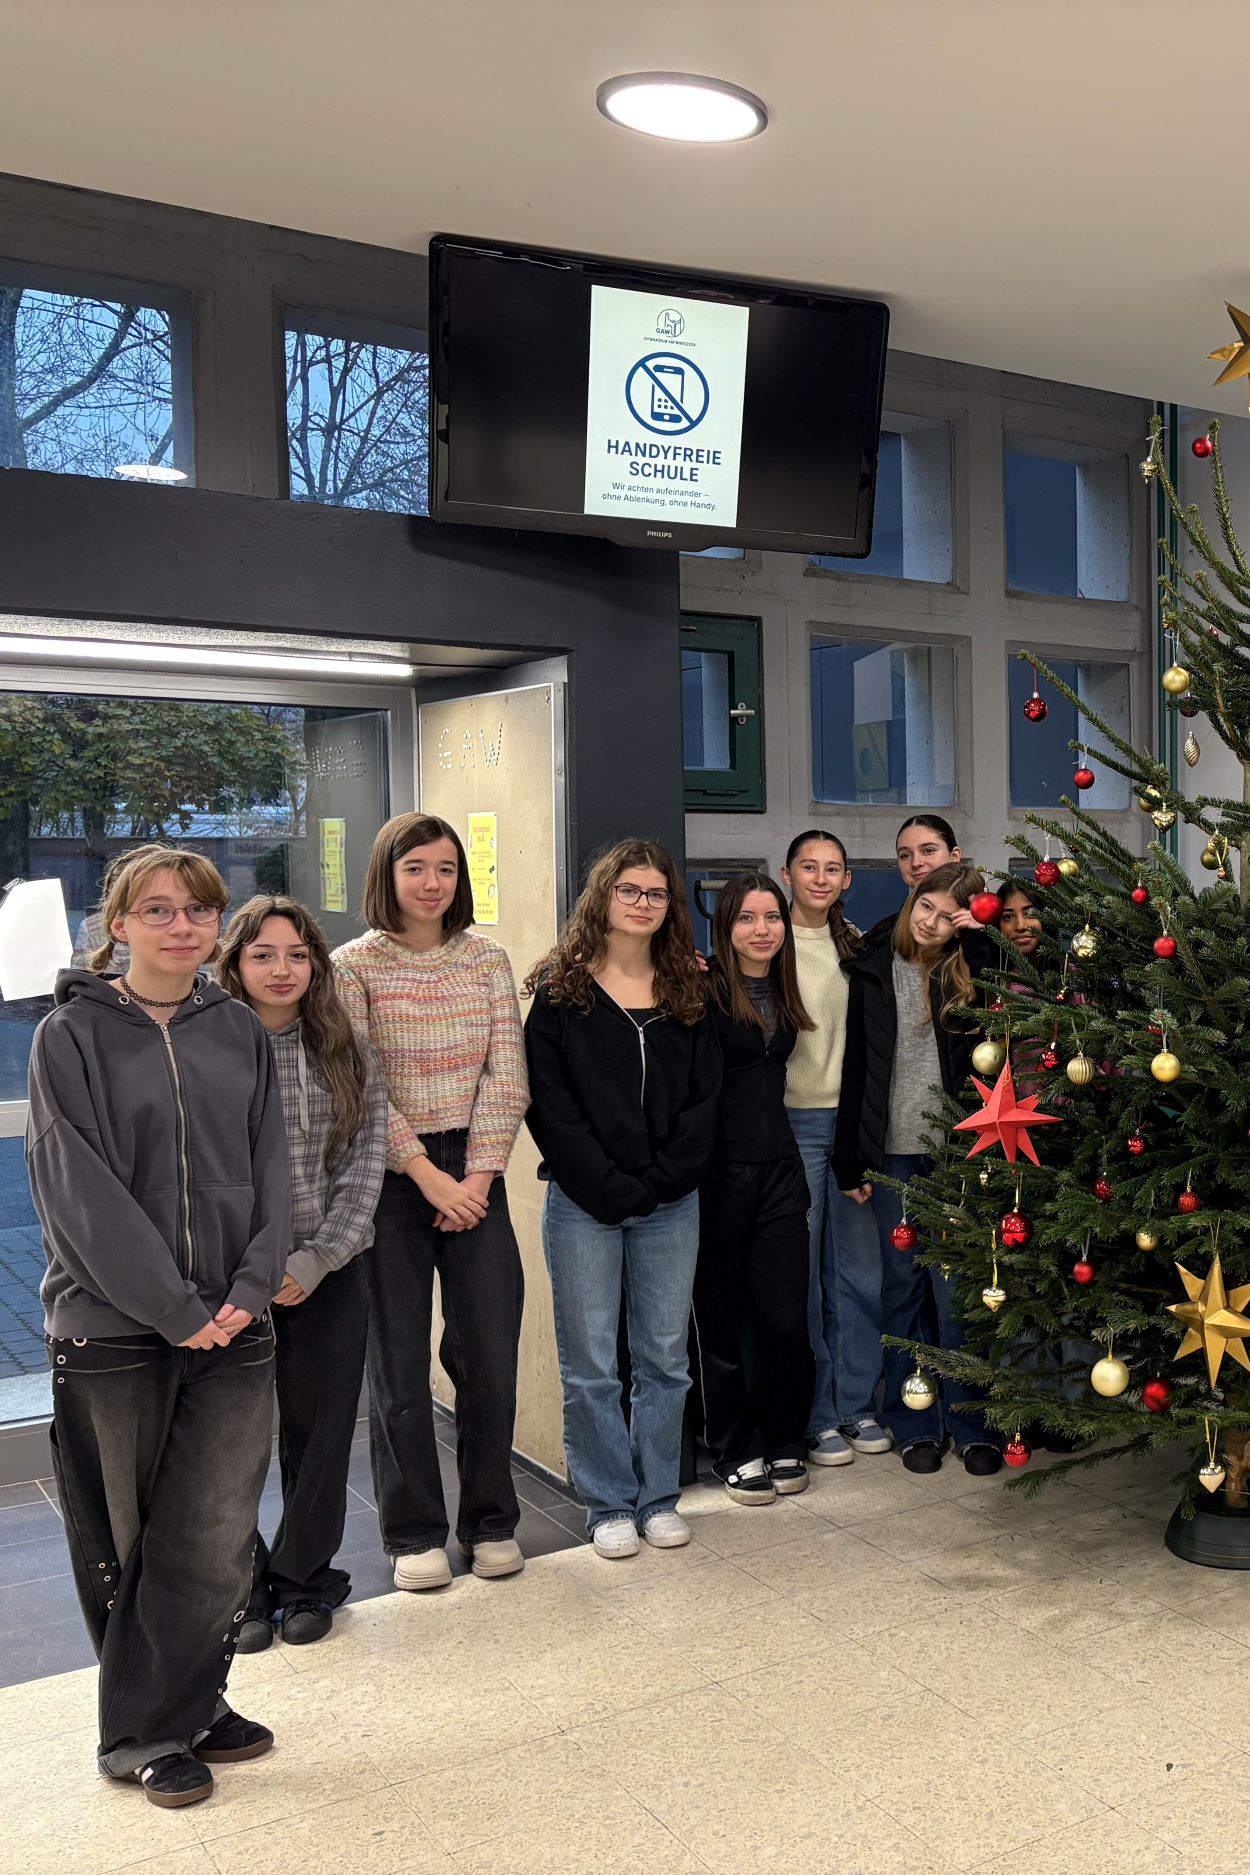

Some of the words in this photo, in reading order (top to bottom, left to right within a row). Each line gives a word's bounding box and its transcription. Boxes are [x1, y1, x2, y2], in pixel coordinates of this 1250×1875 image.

[607, 439, 722, 466] HANDYFREIE
[629, 461, 699, 482] SCHULE
[612, 482, 625, 490] Wir
[627, 484, 654, 493] achten
[656, 487, 701, 498] aufeinander
[602, 492, 621, 501] ohne
[623, 493, 667, 507] Ablenkung,
[669, 499, 688, 508] ohne
[690, 500, 717, 512] Handy.
[647, 530, 672, 539] PHILIPS
[439, 722, 503, 770] GAW
